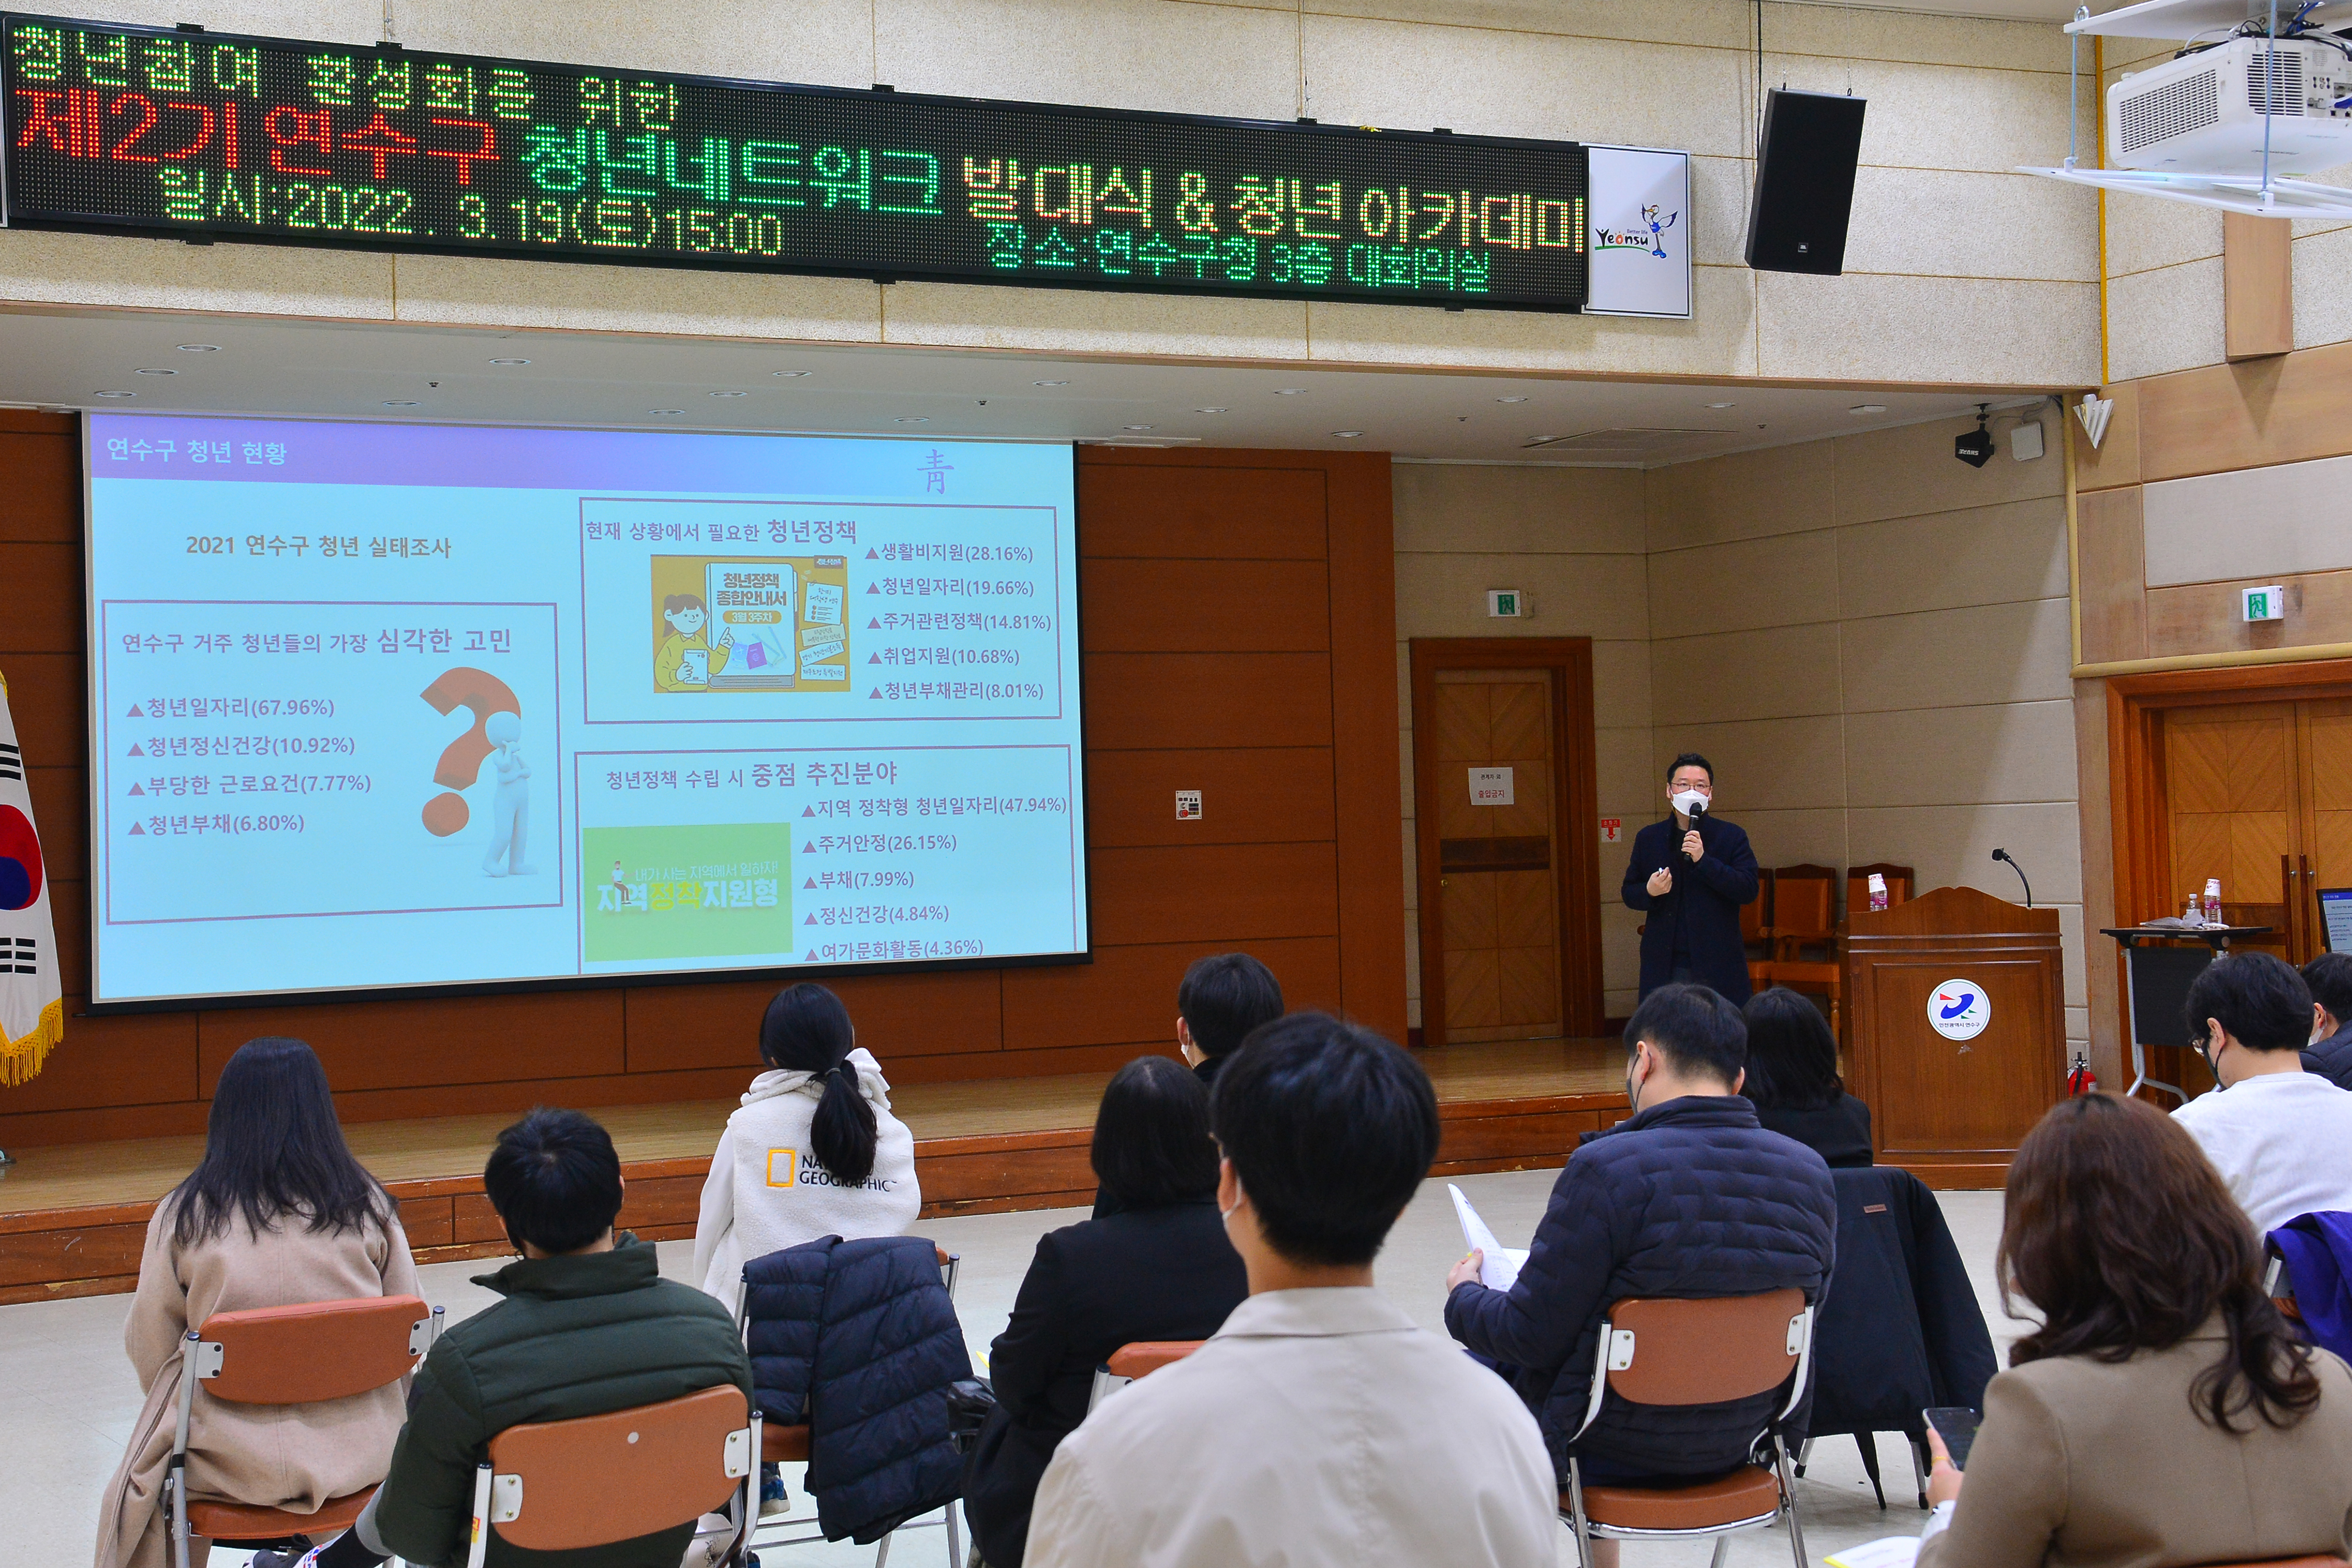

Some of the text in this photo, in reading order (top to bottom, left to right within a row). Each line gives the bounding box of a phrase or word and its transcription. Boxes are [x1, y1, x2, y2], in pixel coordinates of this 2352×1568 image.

[14, 26, 679, 131] 청년참여 활성화를 위한
[15, 88, 1585, 254] 제2기 연수구 청년네트워크 발대식 & 청년 아카데미
[1595, 228, 1648, 247] Yeonsu
[986, 222, 1490, 293] 장소:연수구청 3층 대회의실
[106, 437, 288, 466] 연수구 청년 현황
[586, 518, 858, 545] 현재 상황에서 필요한 청년정책
[186, 534, 452, 560] 2021 연수구 청년 실태조사
[881, 541, 1034, 564] 생활비지원(28.16%)
[723, 573, 779, 589] 청년정책
[882, 577, 1035, 598] 청년일자리(19.66%)
[717, 591, 787, 606] 종합안내서
[732, 612, 773, 623] 3월 3주차
[883, 611, 1052, 633] 주거관련정책(14.81%)
[122, 627, 512, 655] 연수구 거주 청년들의 가장 심각한 고민
[883, 646, 1020, 668] 취업지원(10.68%)
[884, 681, 1044, 702] 청년부채관리(8.01%)
[147, 698, 335, 720] 청년일자리(67.96%)
[147, 736, 356, 758] 청년정신건강(10.92%)
[148, 774, 372, 797] 부당한 근로요건(7.77%)
[606, 760, 898, 790] 청년정책 수립 시 중점 추진분야
[1478, 790, 1505, 798] 출입금지
[818, 796, 1068, 819] 지역 정착형 청년일자리(47.94%)
[148, 814, 305, 835] 청년부채(6.80%)
[818, 834, 958, 855] 주거안정(26.15%)
[636, 861, 779, 881] 내가 사는 지역에서 일하자!
[819, 870, 915, 890] 부채(7.99%)
[597, 878, 779, 912] 지역정착지원형
[820, 905, 950, 926] 정신건강(4.84%)
[821, 939, 985, 961] 여가문화활동(4.36%)
